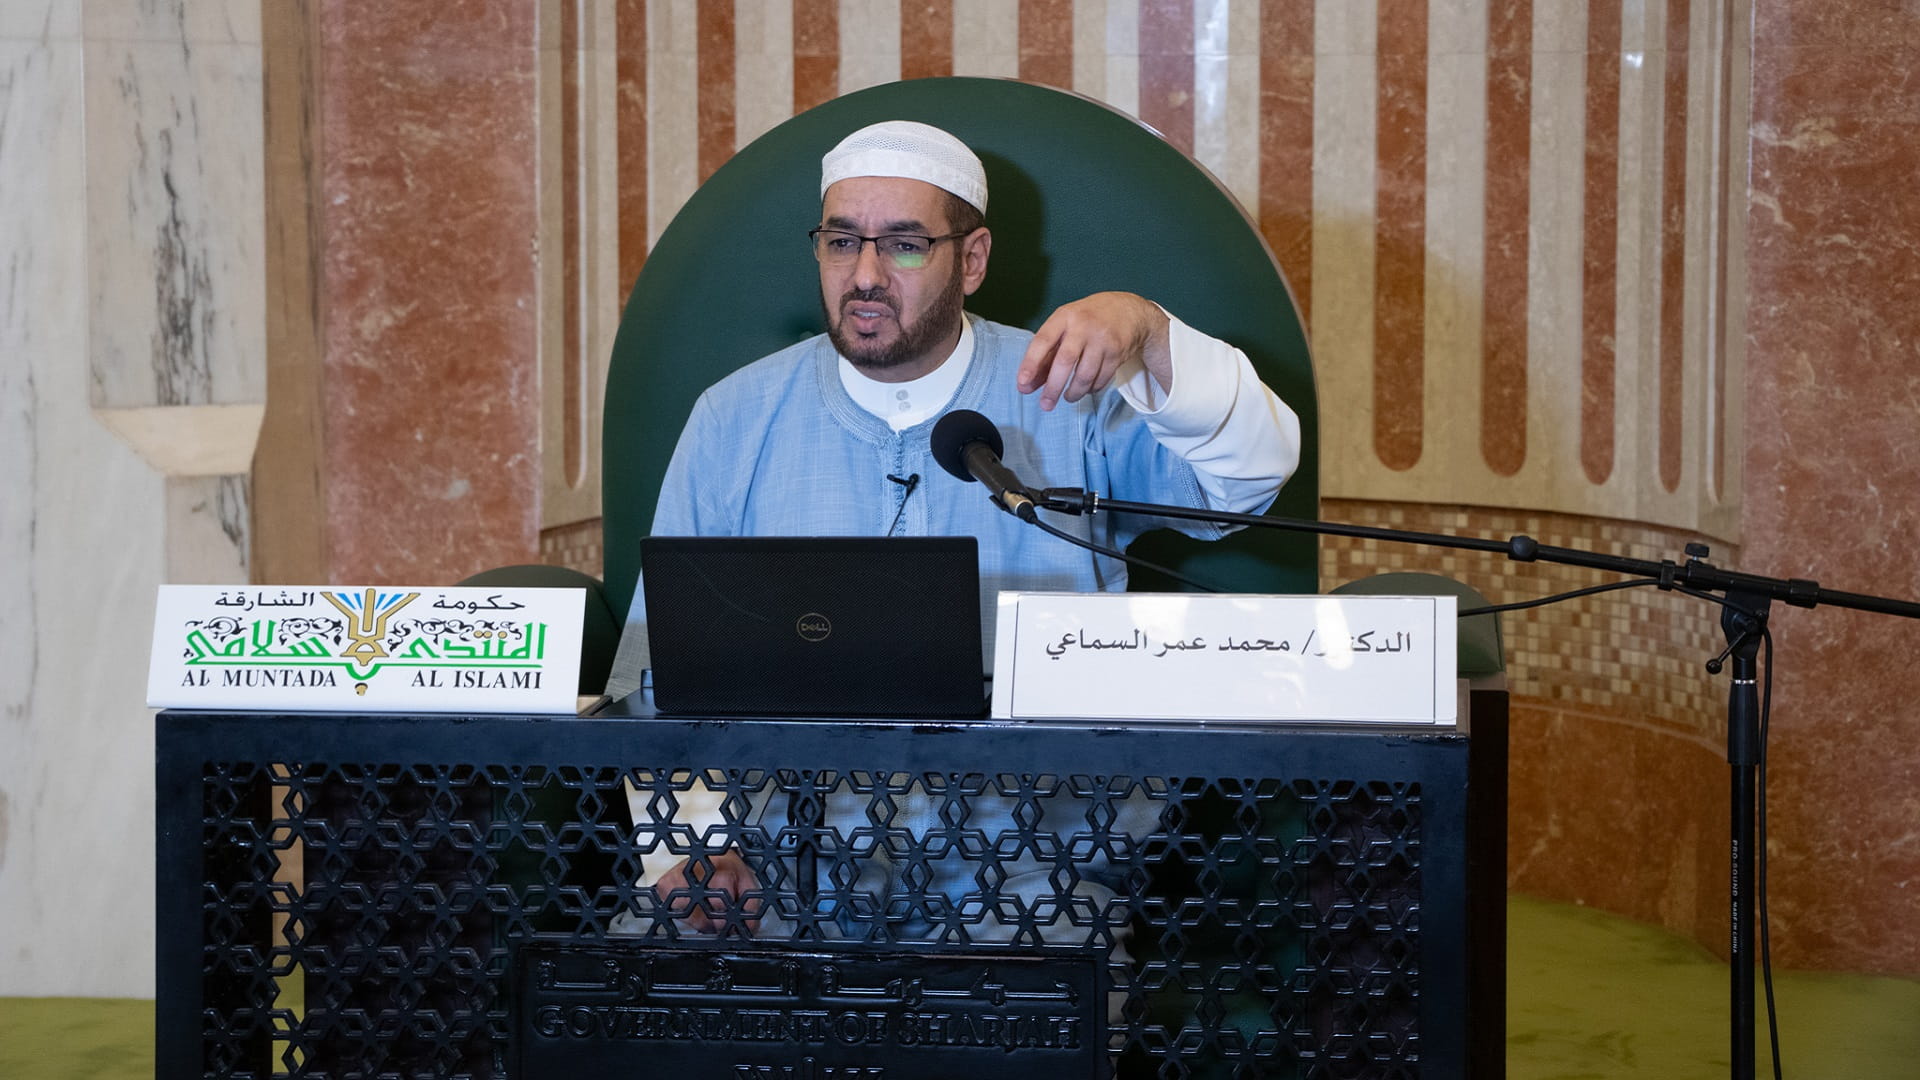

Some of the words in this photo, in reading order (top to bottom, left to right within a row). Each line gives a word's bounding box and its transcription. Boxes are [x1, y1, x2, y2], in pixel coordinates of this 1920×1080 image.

[214, 590, 315, 612] الشارقة
[432, 594, 526, 615] حكومة
[800, 623, 829, 632] DELL
[1046, 628, 1148, 661] السماعي
[1153, 636, 1207, 658] عمر
[1218, 636, 1291, 652] محمد
[181, 669, 211, 688] AL
[222, 669, 338, 688] MUNTADA
[411, 670, 444, 688] AL
[454, 670, 543, 690] ISLAMI
[533, 1004, 829, 1043] GOVERNMENT
[831, 1010, 889, 1043] OF
[898, 1012, 1082, 1051] SHARJAH
